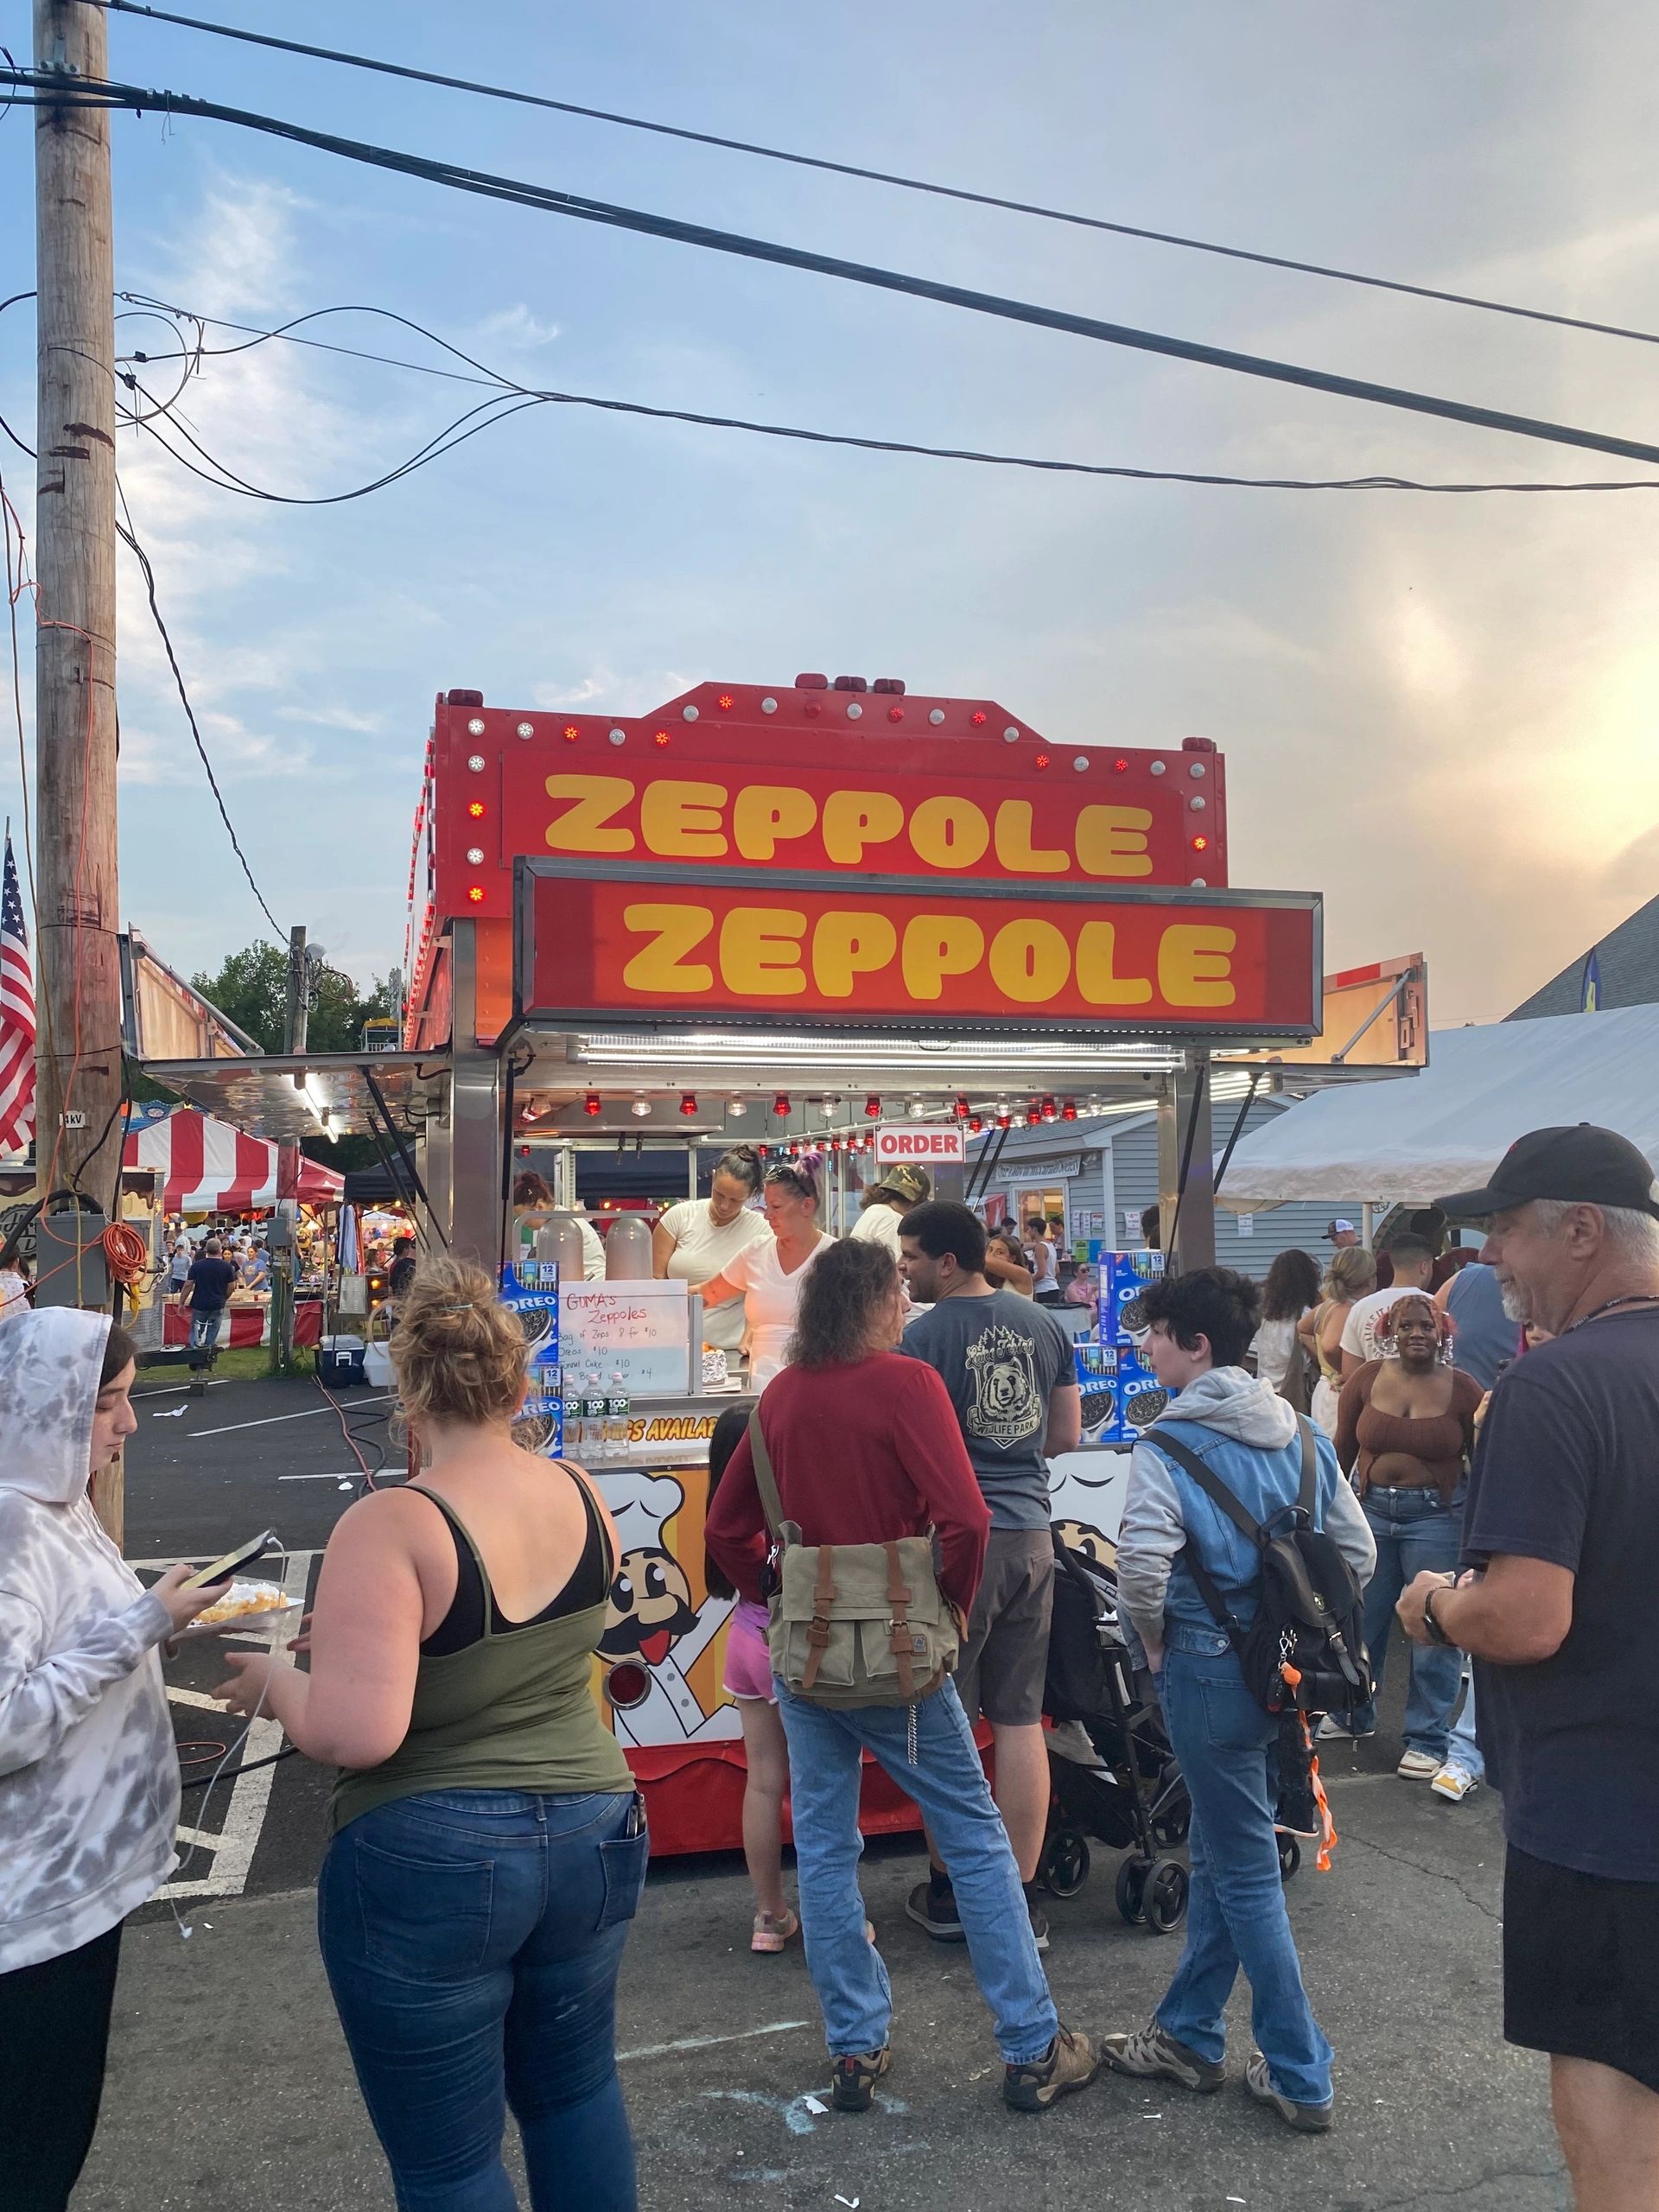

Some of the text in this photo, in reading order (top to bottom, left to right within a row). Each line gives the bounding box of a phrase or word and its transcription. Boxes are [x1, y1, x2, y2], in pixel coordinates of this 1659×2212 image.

[548, 777, 1150, 874] ZEPPOLE
[626, 906, 1234, 1005] ZEPPOLE
[880, 1135, 959, 1154] ORDER
[503, 1296, 556, 1313] OREO
[588, 1306, 647, 1325] Zeppoles
[580, 1330, 587, 1339] of
[592, 1329, 609, 1339] Zeps
[645, 1327, 658, 1337] $10
[594, 1346, 608, 1356] $10
[585, 1359, 602, 1370] Cake
[616, 1358, 631, 1368] $10
[641, 1368, 652, 1379] $4
[517, 1402, 561, 1418] REO
[587, 1400, 604, 1409] 100
[1014, 1420, 1035, 1433] PARK
